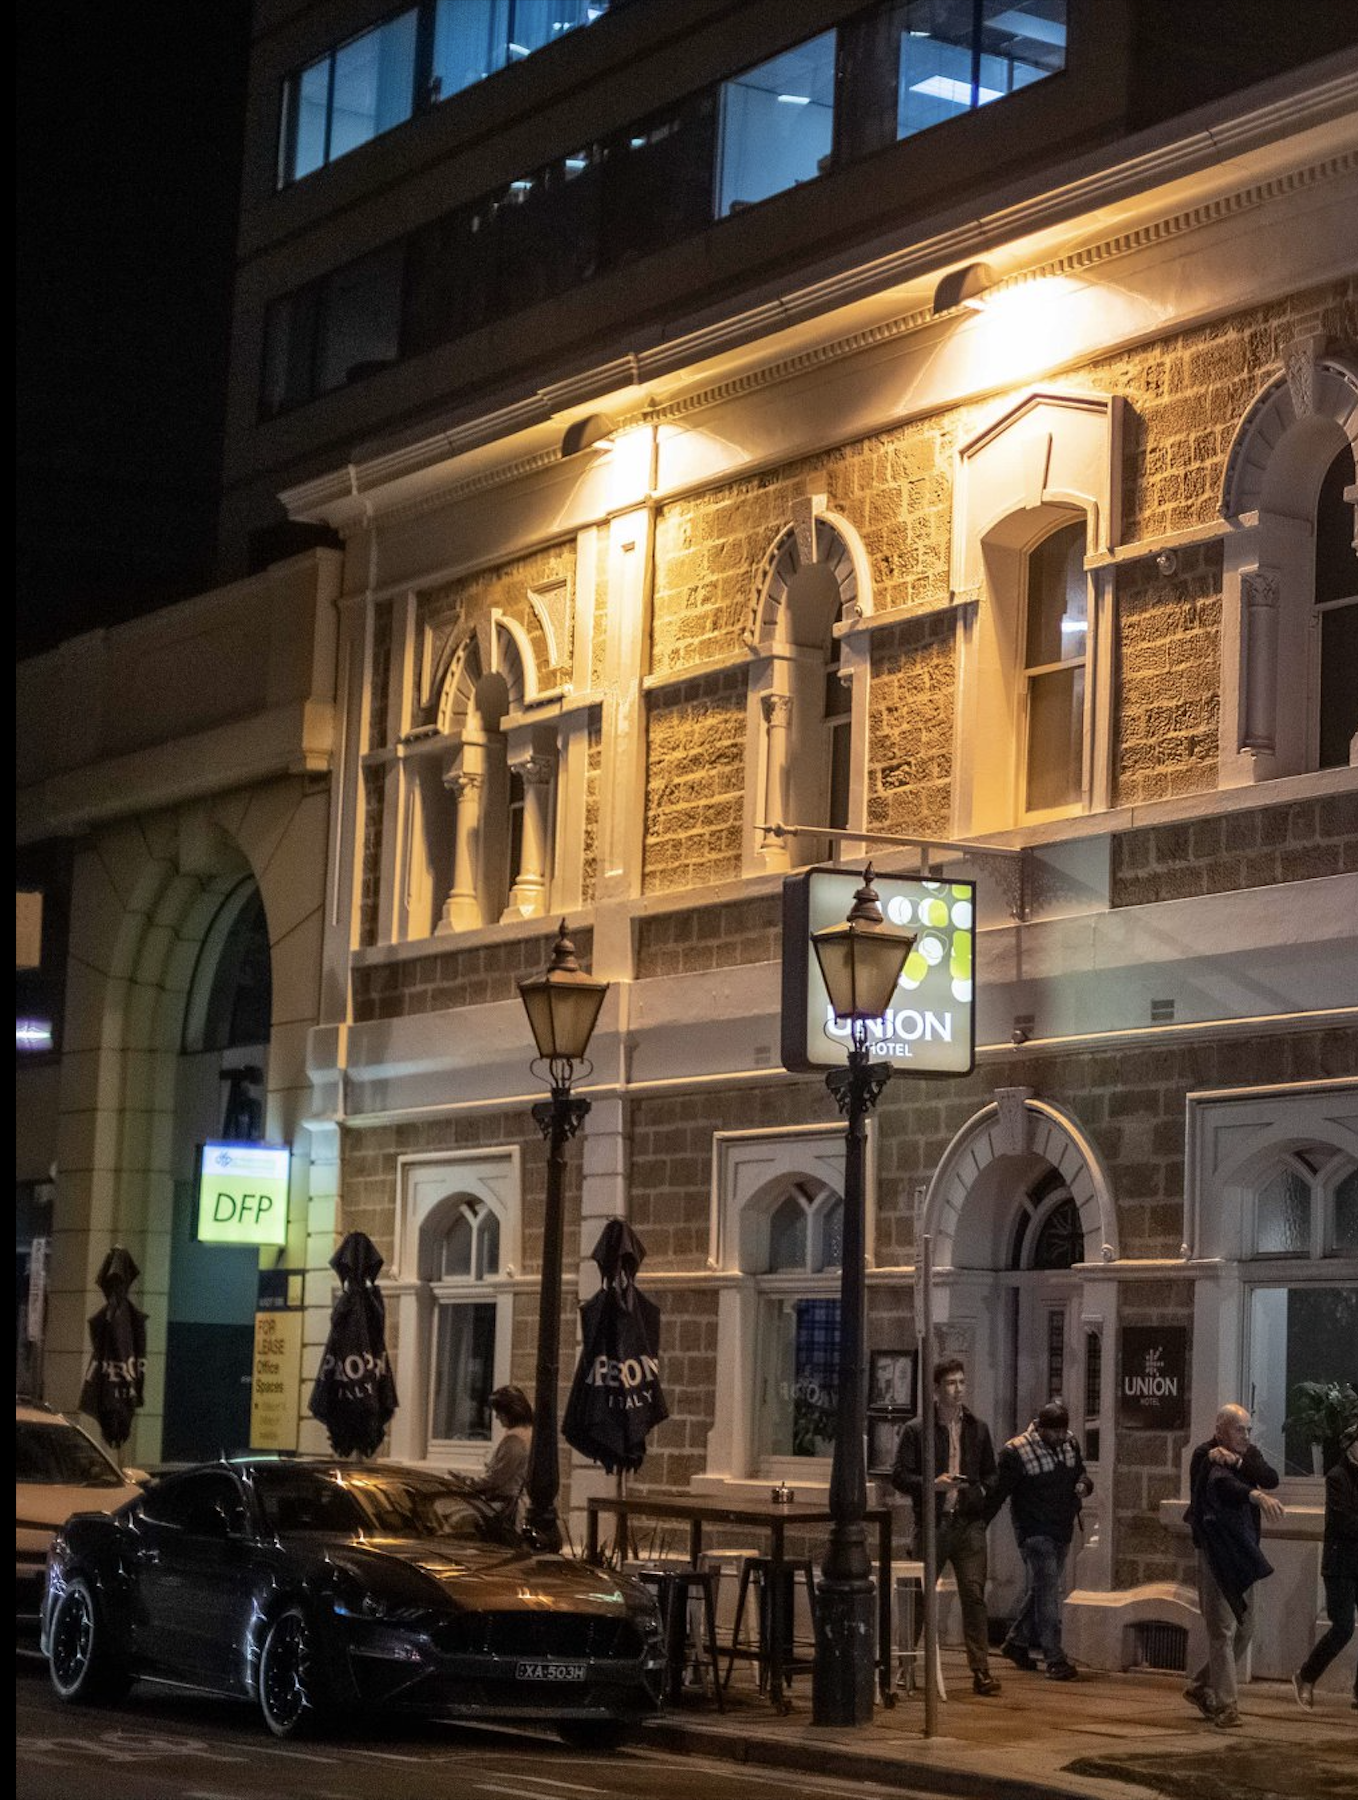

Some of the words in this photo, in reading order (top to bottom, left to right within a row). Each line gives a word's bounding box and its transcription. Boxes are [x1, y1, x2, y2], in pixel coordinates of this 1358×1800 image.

[826, 1003, 952, 1042] UNION
[213, 1193, 273, 1224] DFP
[256, 1339, 285, 1355] LEASE
[256, 1360, 280, 1375] Office
[256, 1379, 284, 1395] Spaces
[1125, 1376, 1177, 1396] UNION
